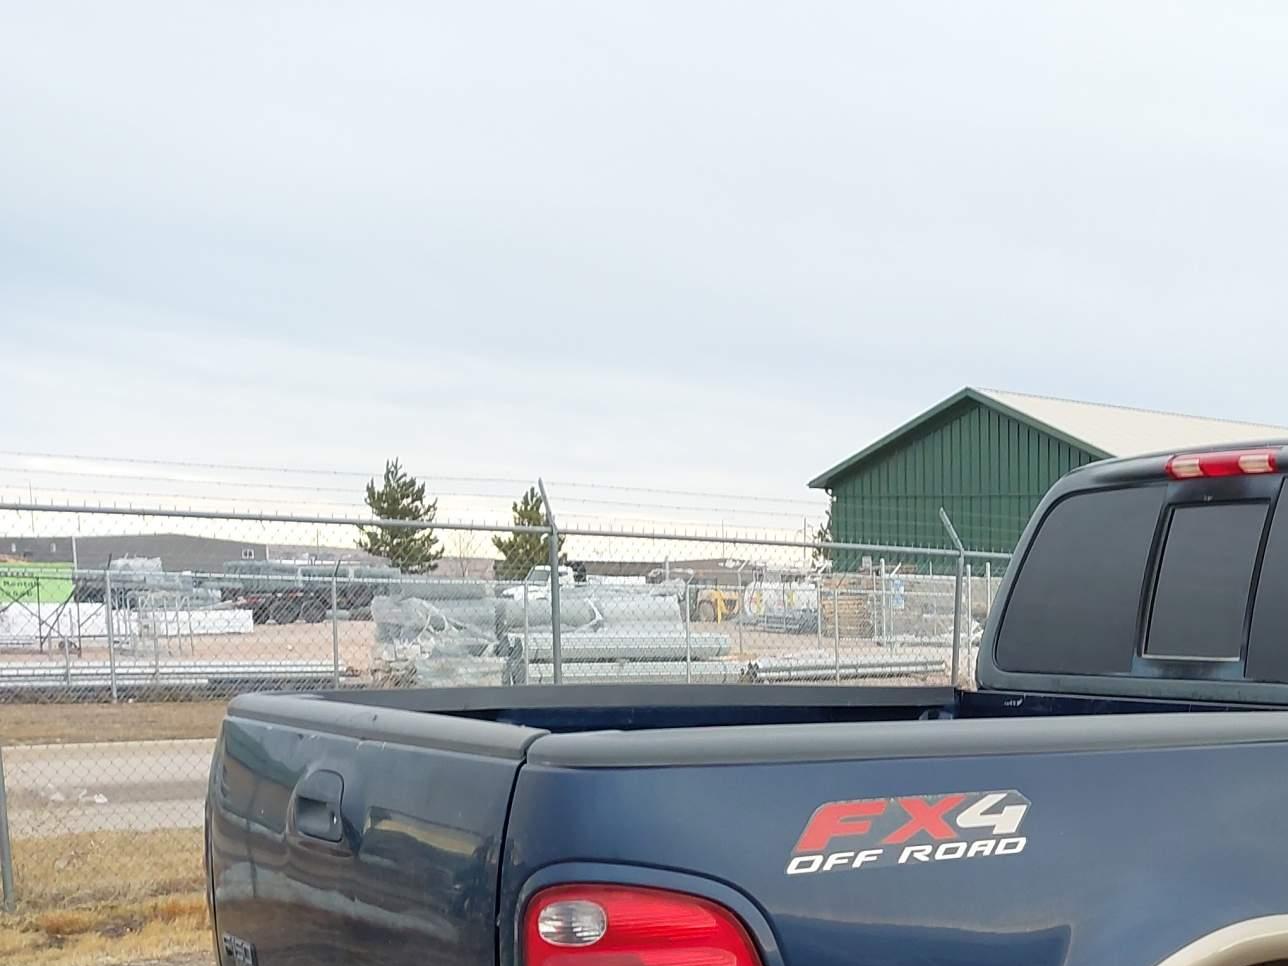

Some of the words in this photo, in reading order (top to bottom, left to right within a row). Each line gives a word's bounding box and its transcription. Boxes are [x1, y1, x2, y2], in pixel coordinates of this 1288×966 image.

[793, 793, 1028, 852] FX4
[787, 849, 883, 875] OFF
[897, 836, 1026, 864] ROAD
